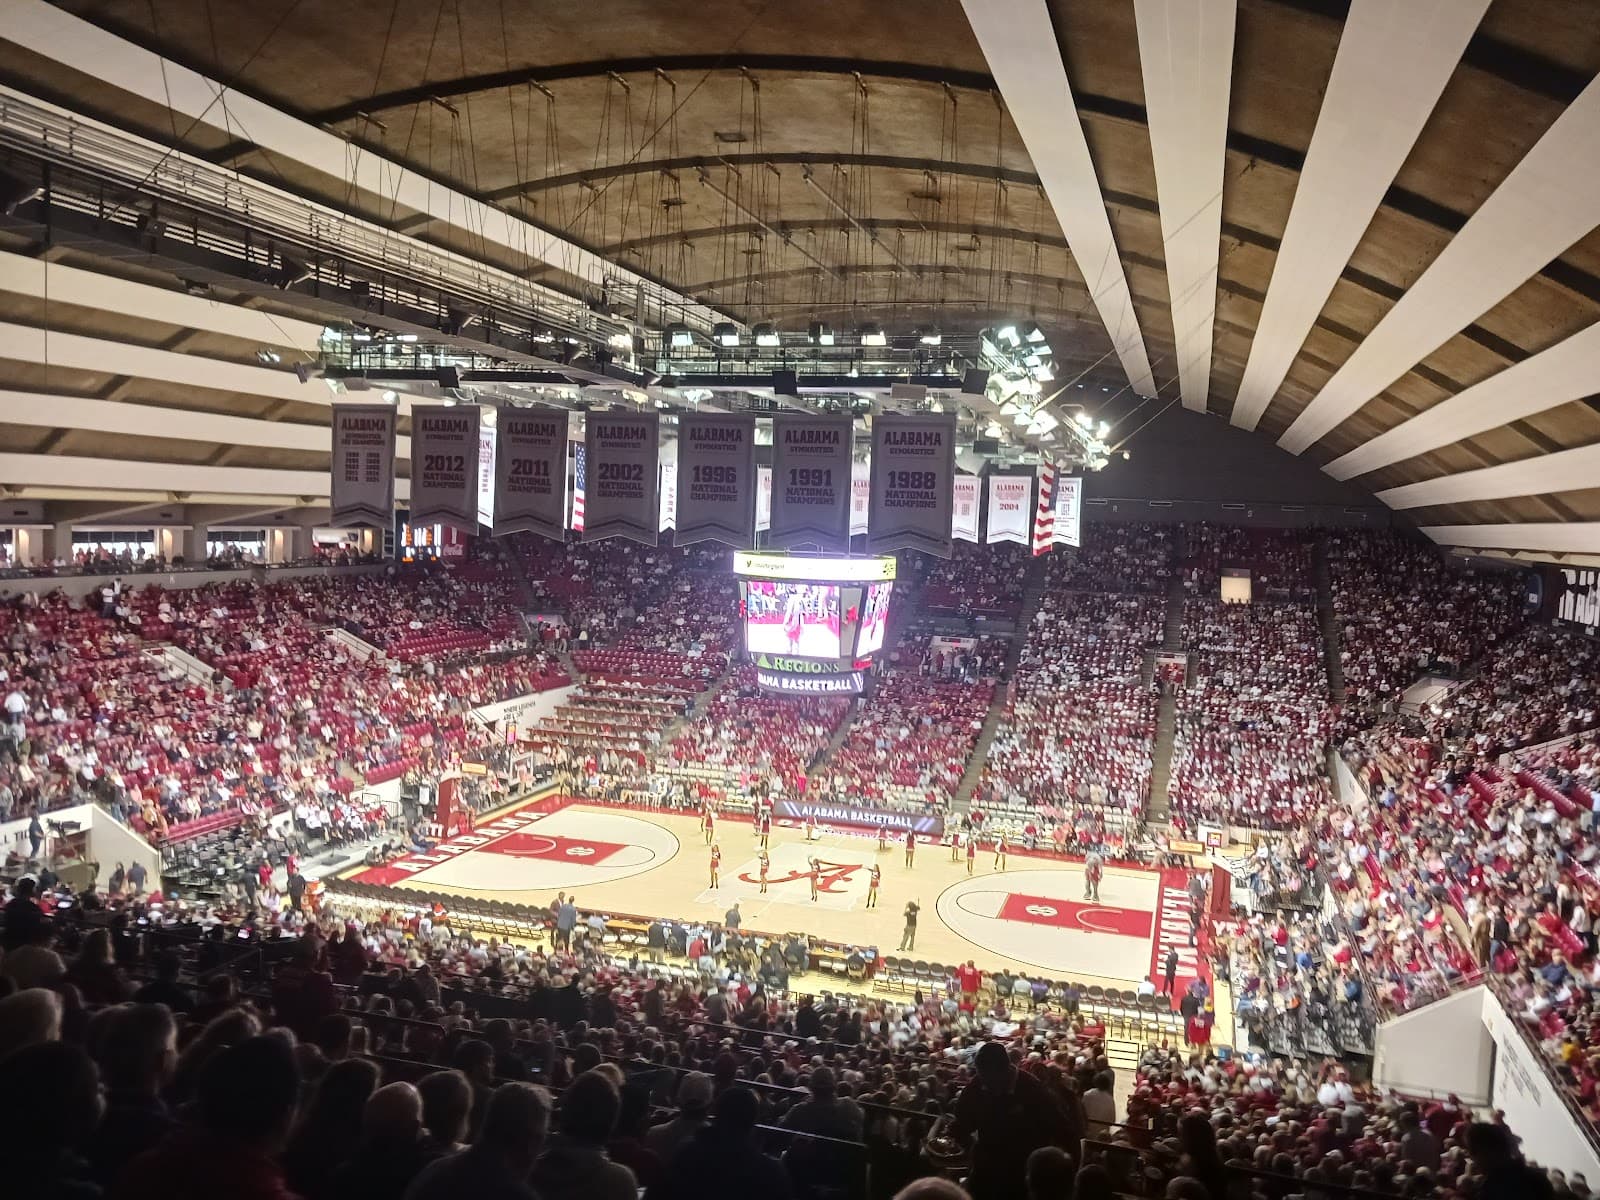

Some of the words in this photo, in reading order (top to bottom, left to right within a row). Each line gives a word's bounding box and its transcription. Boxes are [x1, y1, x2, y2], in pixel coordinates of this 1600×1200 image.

[341, 418, 386, 432] ALABAMA
[422, 419, 468, 432] ALABAMA
[507, 422, 556, 437] ALABAMA
[596, 426, 646, 440] ALABAMA
[690, 428, 742, 442] ALABAMA
[785, 430, 840, 444] ALABAMA
[884, 431, 941, 446] ALABAMA
[424, 454, 465, 471] 2012
[511, 458, 549, 476] 2011
[423, 472, 465, 481] NATIONAL
[598, 463, 644, 480] 2002
[693, 465, 737, 483] 1996
[789, 469, 832, 486] 1991
[508, 476, 552, 486] NATIONAL
[598, 481, 644, 490] NATIONAL
[887, 470, 937, 489] 1988
[691, 484, 738, 493] NATIONAL
[785, 487, 835, 496] NATIONAL
[885, 490, 937, 500] NATIONAL
[996, 484, 1024, 492] ALABAMA
[999, 503, 1019, 511] 2004
[773, 657, 840, 673] REGIONS
[782, 677, 852, 690] BASKETBALL
[802, 805, 849, 820] ALABAMA
[851, 810, 913, 828] BASKETBALL
[392, 809, 548, 873] ALABAMA
